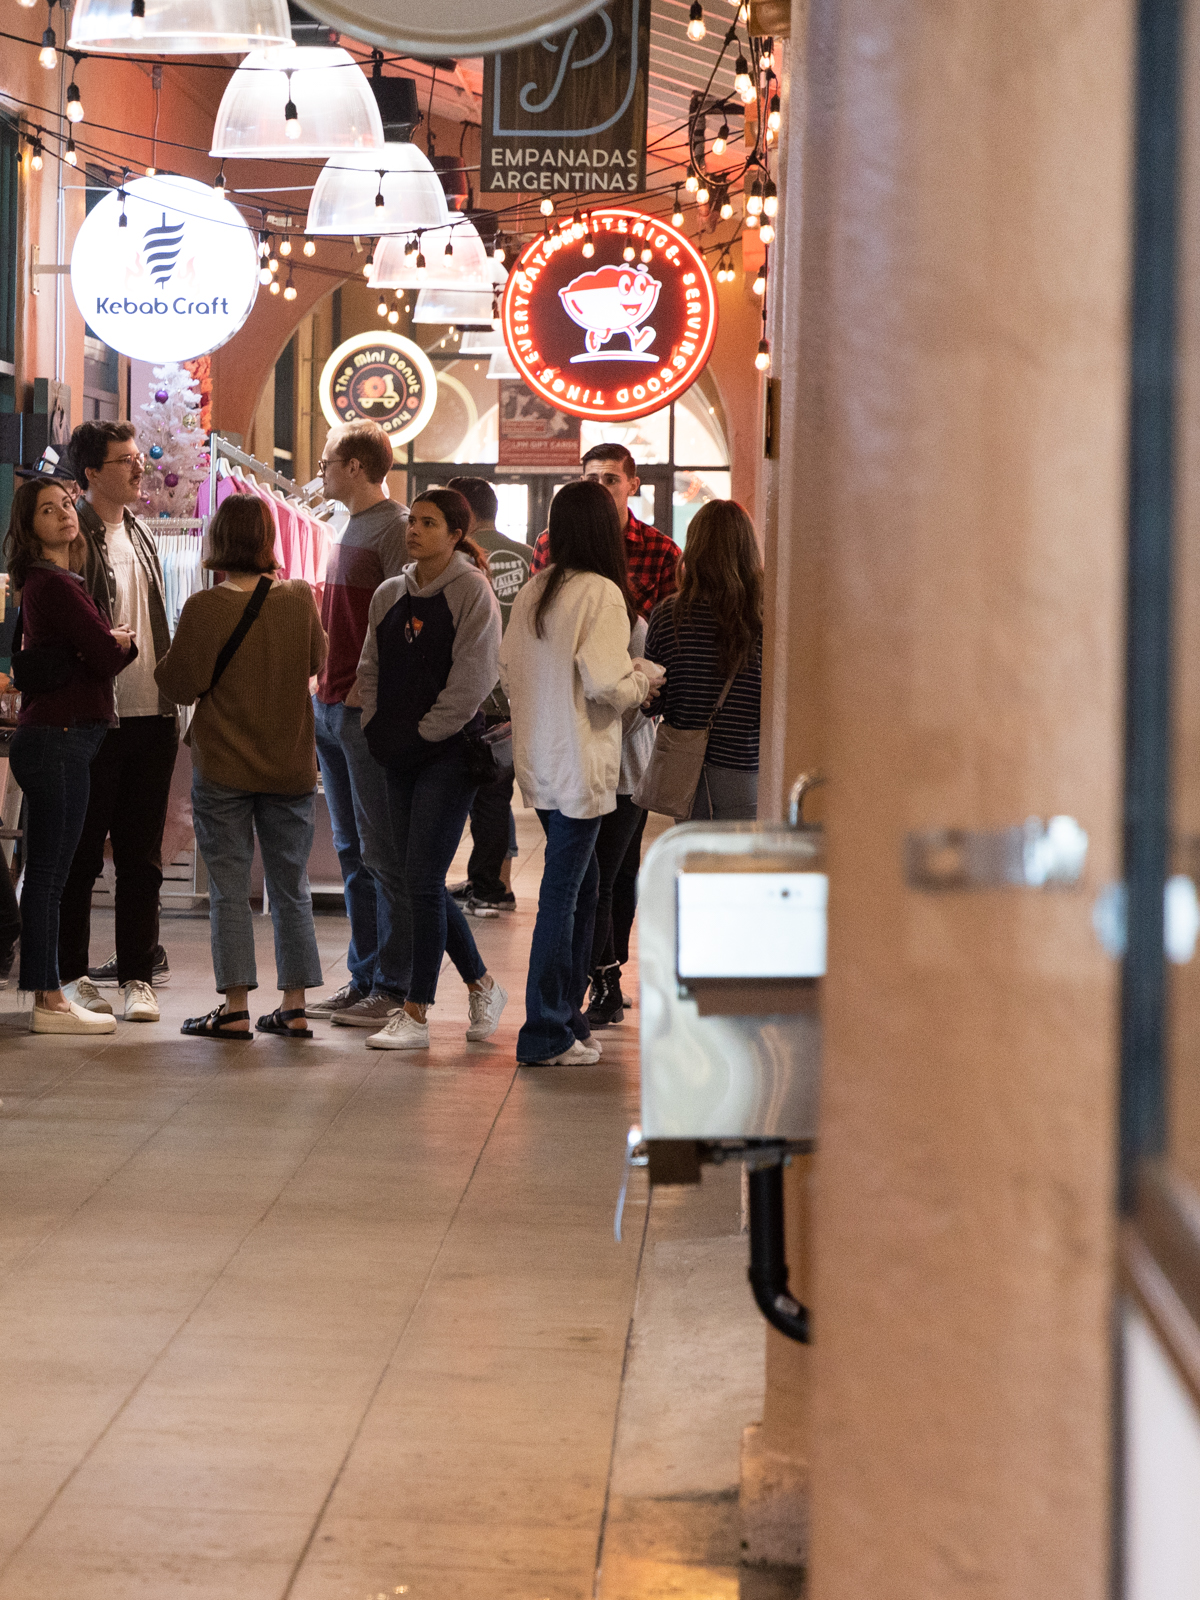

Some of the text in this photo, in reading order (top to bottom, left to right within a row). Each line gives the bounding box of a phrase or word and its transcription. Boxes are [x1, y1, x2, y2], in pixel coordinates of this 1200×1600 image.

[491, 148, 638, 168] EMPANADAS
[490, 171, 638, 191] ARGENTINAS
[96, 296, 229, 315] Kebab Craft
[673, 272, 702, 370] SERVING
[335, 366, 354, 393] The
[388, 352, 420, 394] Donut
[616, 367, 674, 403] GOOD
[498, 585, 520, 598] FARM
